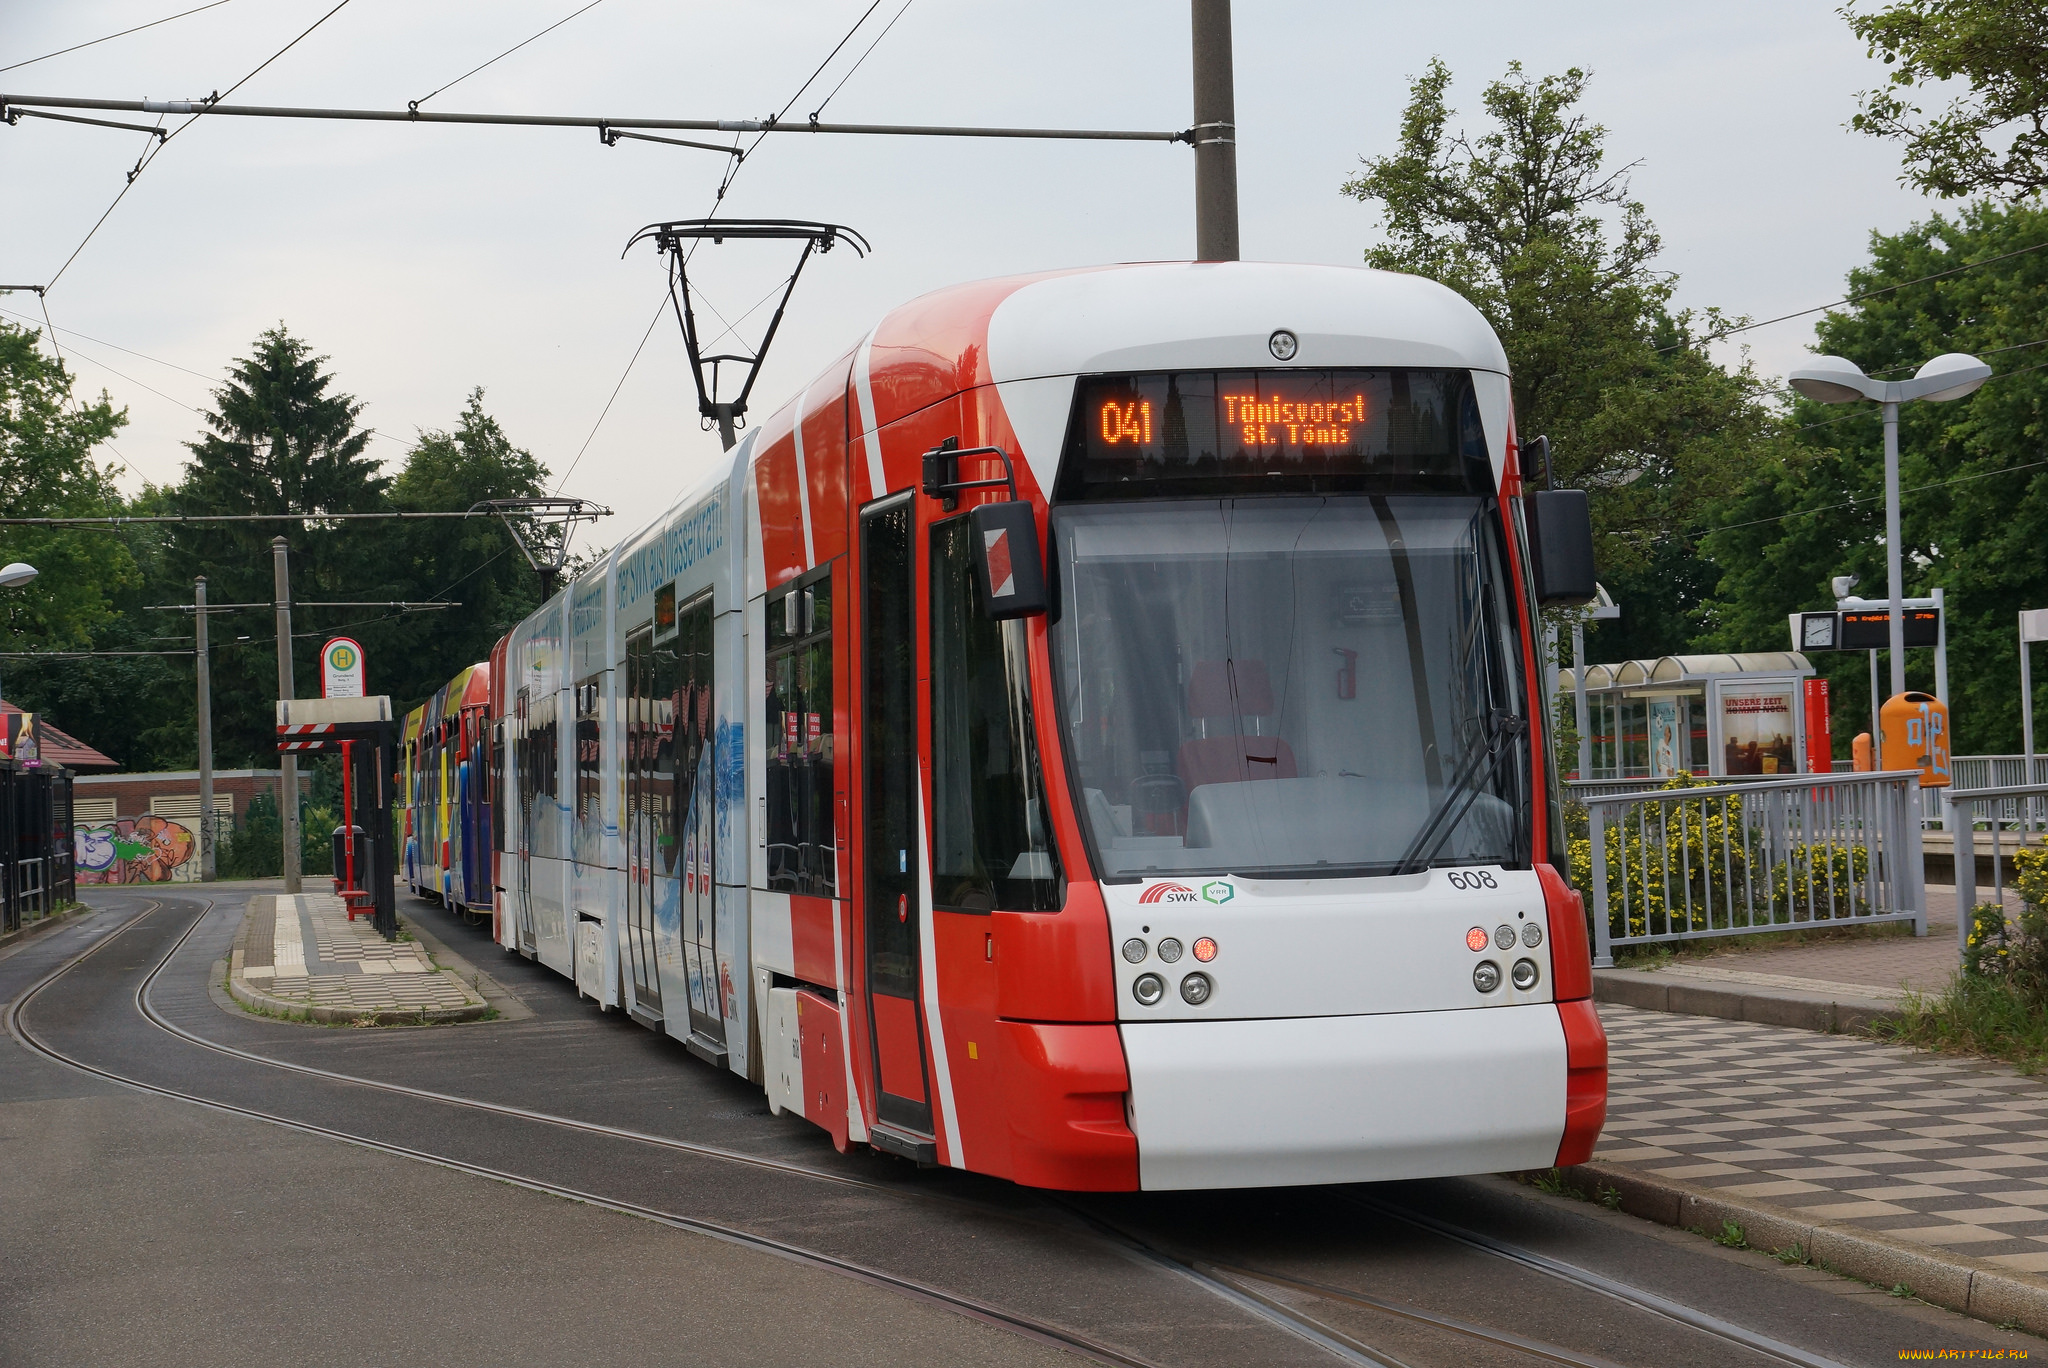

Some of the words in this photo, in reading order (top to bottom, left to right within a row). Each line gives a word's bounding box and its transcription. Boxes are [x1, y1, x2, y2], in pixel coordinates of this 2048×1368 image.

[1224, 395, 1365, 422] Tönisvorst
[1102, 402, 1151, 443] 041
[1243, 424, 1276, 444] St.
[1286, 424, 1350, 444] Tönis
[1820, 681, 1828, 695] SOS
[1725, 698, 1761, 707] UNSERE
[1763, 697, 1783, 706] ZEIT
[1447, 870, 1498, 890] 608
[1166, 893, 1198, 903] SWK
